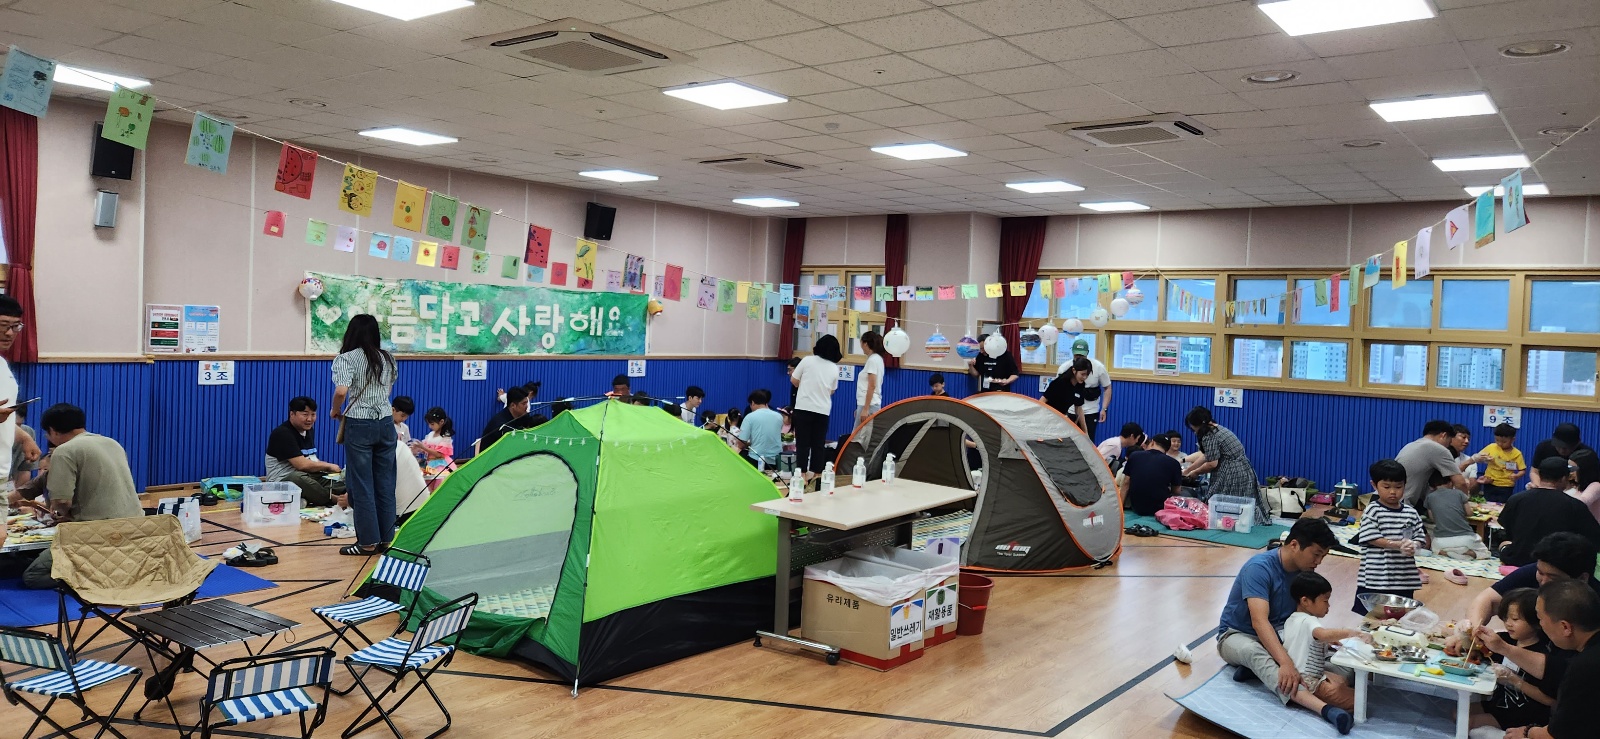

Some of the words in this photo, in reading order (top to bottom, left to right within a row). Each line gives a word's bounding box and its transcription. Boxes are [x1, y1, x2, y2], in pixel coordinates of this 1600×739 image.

[490, 303, 624, 349] 사랑해요
[204, 371, 212, 381] 3
[215, 371, 229, 381] 조
[466, 368, 471, 377] 4
[473, 368, 483, 377] 조
[1218, 395, 1225, 404] 8
[1227, 396, 1238, 405] 조
[1489, 415, 1497, 424] 9
[1502, 416, 1514, 425] 조
[826, 593, 860, 610] 유리제품
[927, 604, 953, 621] 재활용품
[890, 619, 922, 642] 일반쓰레기
